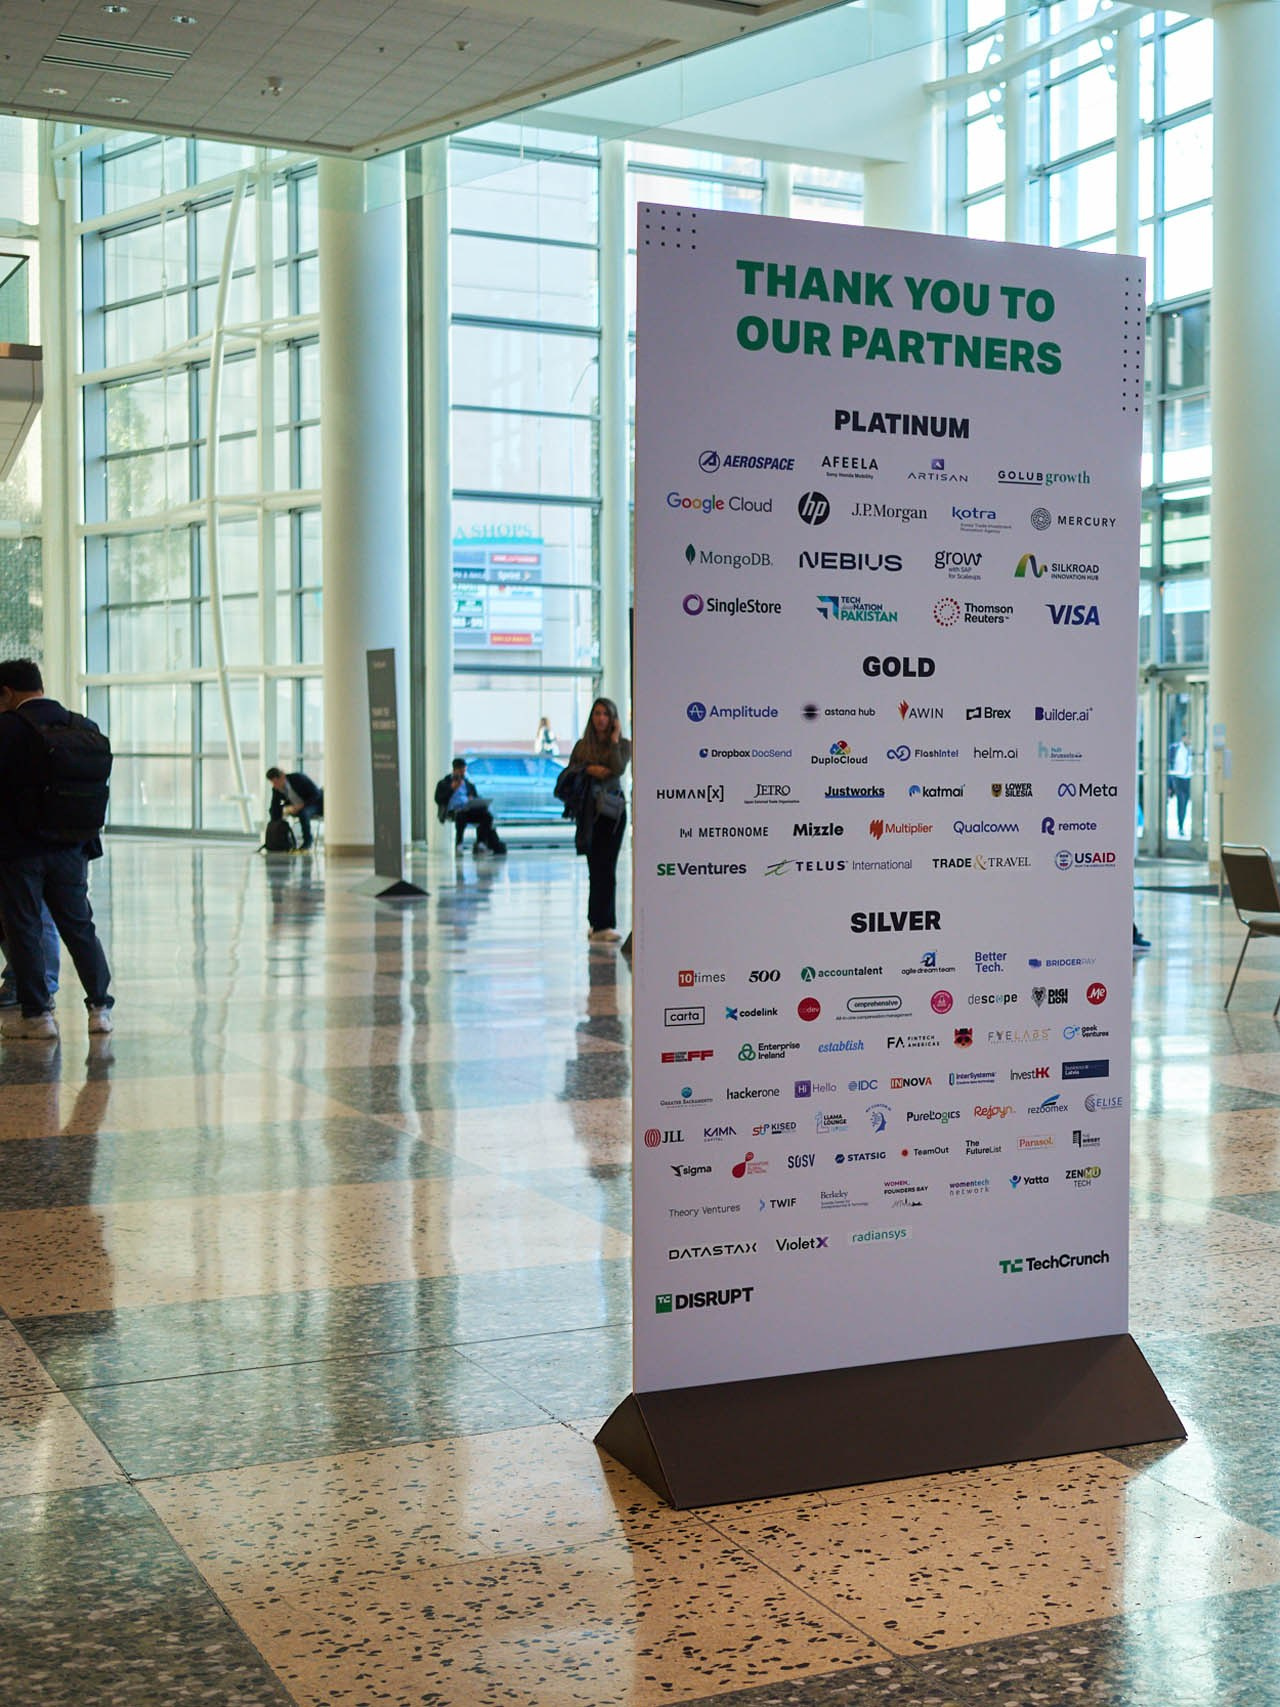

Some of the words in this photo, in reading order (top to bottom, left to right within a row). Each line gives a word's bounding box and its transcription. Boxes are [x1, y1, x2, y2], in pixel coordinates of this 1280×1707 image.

[736, 259, 893, 307] THANK
[904, 276, 989, 317] YOU
[1000, 285, 1055, 323] TO
[736, 315, 831, 357] OUR
[842, 324, 1062, 375] PARTNERS
[834, 409, 970, 439] PLATINUM
[723, 454, 795, 471] AEROSPACE
[821, 455, 879, 470] AFEELA
[907, 472, 968, 483] ARTISAN
[998, 470, 1044, 481] GOLUB
[1045, 470, 1091, 487] growth
[666, 491, 725, 514] Google
[728, 496, 773, 513] Cloud
[801, 491, 826, 526] hp
[851, 503, 928, 523] J.P.Morgan
[952, 506, 997, 521] kotra
[1057, 515, 1117, 528] MERCURY
[799, 551, 903, 572] NEBIUS
[934, 550, 982, 569] grow
[1051, 563, 1100, 574] SILKROAD
[841, 596, 861, 604] TECH
[706, 598, 782, 616] SingleStore
[964, 602, 1014, 614] Thomson
[840, 610, 898, 623] PAKISTAN
[1045, 603, 1101, 626] VISA
[862, 655, 936, 678] GOLD
[709, 705, 779, 720] Amplitude
[824, 707, 856, 716] astana
[858, 707, 876, 717] hub
[908, 708, 944, 719] AWIN
[984, 706, 1011, 719] Brex
[1034, 706, 1090, 722] Builder.ai
[711, 749, 750, 760] Dropbox
[752, 748, 792, 758] DocSend
[973, 746, 1019, 759] helm.ai
[811, 755, 868, 767] DuploCloud
[753, 783, 791, 799] JETRO
[824, 785, 885, 798] Justworks
[922, 784, 964, 798] katmai
[1005, 782, 1032, 791] LOWER
[1079, 783, 1118, 798] Meta
[1005, 789, 1033, 798] SILESIA
[698, 826, 769, 838] METRONOME
[792, 822, 844, 838] Mizzle
[885, 822, 934, 836] Multiplier
[953, 820, 1020, 835] Qualcomm
[1058, 821, 1097, 831] remote
[932, 857, 972, 869] TRADE
[973, 854, 988, 871] &
[987, 856, 1032, 868] TRAVEL
[1074, 852, 1116, 864] USAID
[796, 860, 846, 872] TELUS
[852, 859, 912, 871] International
[850, 910, 942, 933] SILVER
[974, 951, 1007, 962] Better
[817, 966, 883, 978] accountalent
[974, 962, 1004, 973] Tech.
[748, 969, 781, 983] 500
[1048, 987, 1068, 997] DIGI
[1048, 996, 1069, 1005] LION
[670, 1011, 700, 1023] carta
[739, 1006, 778, 1018] codelink
[1081, 1025, 1098, 1033] geek
[1081, 1030, 1109, 1038] ventures
[758, 1041, 800, 1052] Enterprise
[818, 1040, 865, 1053] establish
[758, 1051, 786, 1060] Ireland
[1010, 1066, 1050, 1081] InvestHK
[812, 1082, 837, 1094] Hello
[858, 1079, 878, 1091] IDC
[891, 1077, 933, 1089] INNOVA
[726, 1087, 780, 1101] hackerone
[1095, 1097, 1123, 1108] ELISE
[823, 1112, 843, 1120] LLAMA
[1027, 1104, 1069, 1115] rezoomex
[823, 1118, 847, 1126] LOUNGE
[906, 1109, 961, 1124] PureLogics
[703, 1126, 737, 1137] KAMA
[771, 1121, 797, 1131] KISED
[662, 1129, 685, 1144] JLL
[966, 1139, 980, 1147] The
[847, 1151, 887, 1162] STATSIG
[913, 1146, 949, 1157] TeamOut
[965, 1146, 1002, 1156] FutureList
[787, 1153, 816, 1169] SOSV
[682, 1163, 712, 1176] sigma
[1065, 1166, 1101, 1180] ZENMU
[949, 1179, 990, 1189] womentech
[1023, 1175, 1049, 1185] Yatta
[1073, 1179, 1092, 1188] TECH
[884, 1186, 916, 1195] FOUNDERS
[916, 1185, 929, 1193] BAY
[949, 1187, 990, 1196] network
[769, 1198, 797, 1209] TWIF
[668, 1207, 699, 1218] Theory
[702, 1204, 741, 1216] Ventures
[852, 1227, 908, 1244] radiansys
[776, 1236, 829, 1252] VioletX
[668, 1242, 757, 1260] DATASTAX
[999, 1258, 1024, 1274] TC
[1026, 1249, 1110, 1272] TechCrunch
[675, 1286, 754, 1310] DISRUPT
